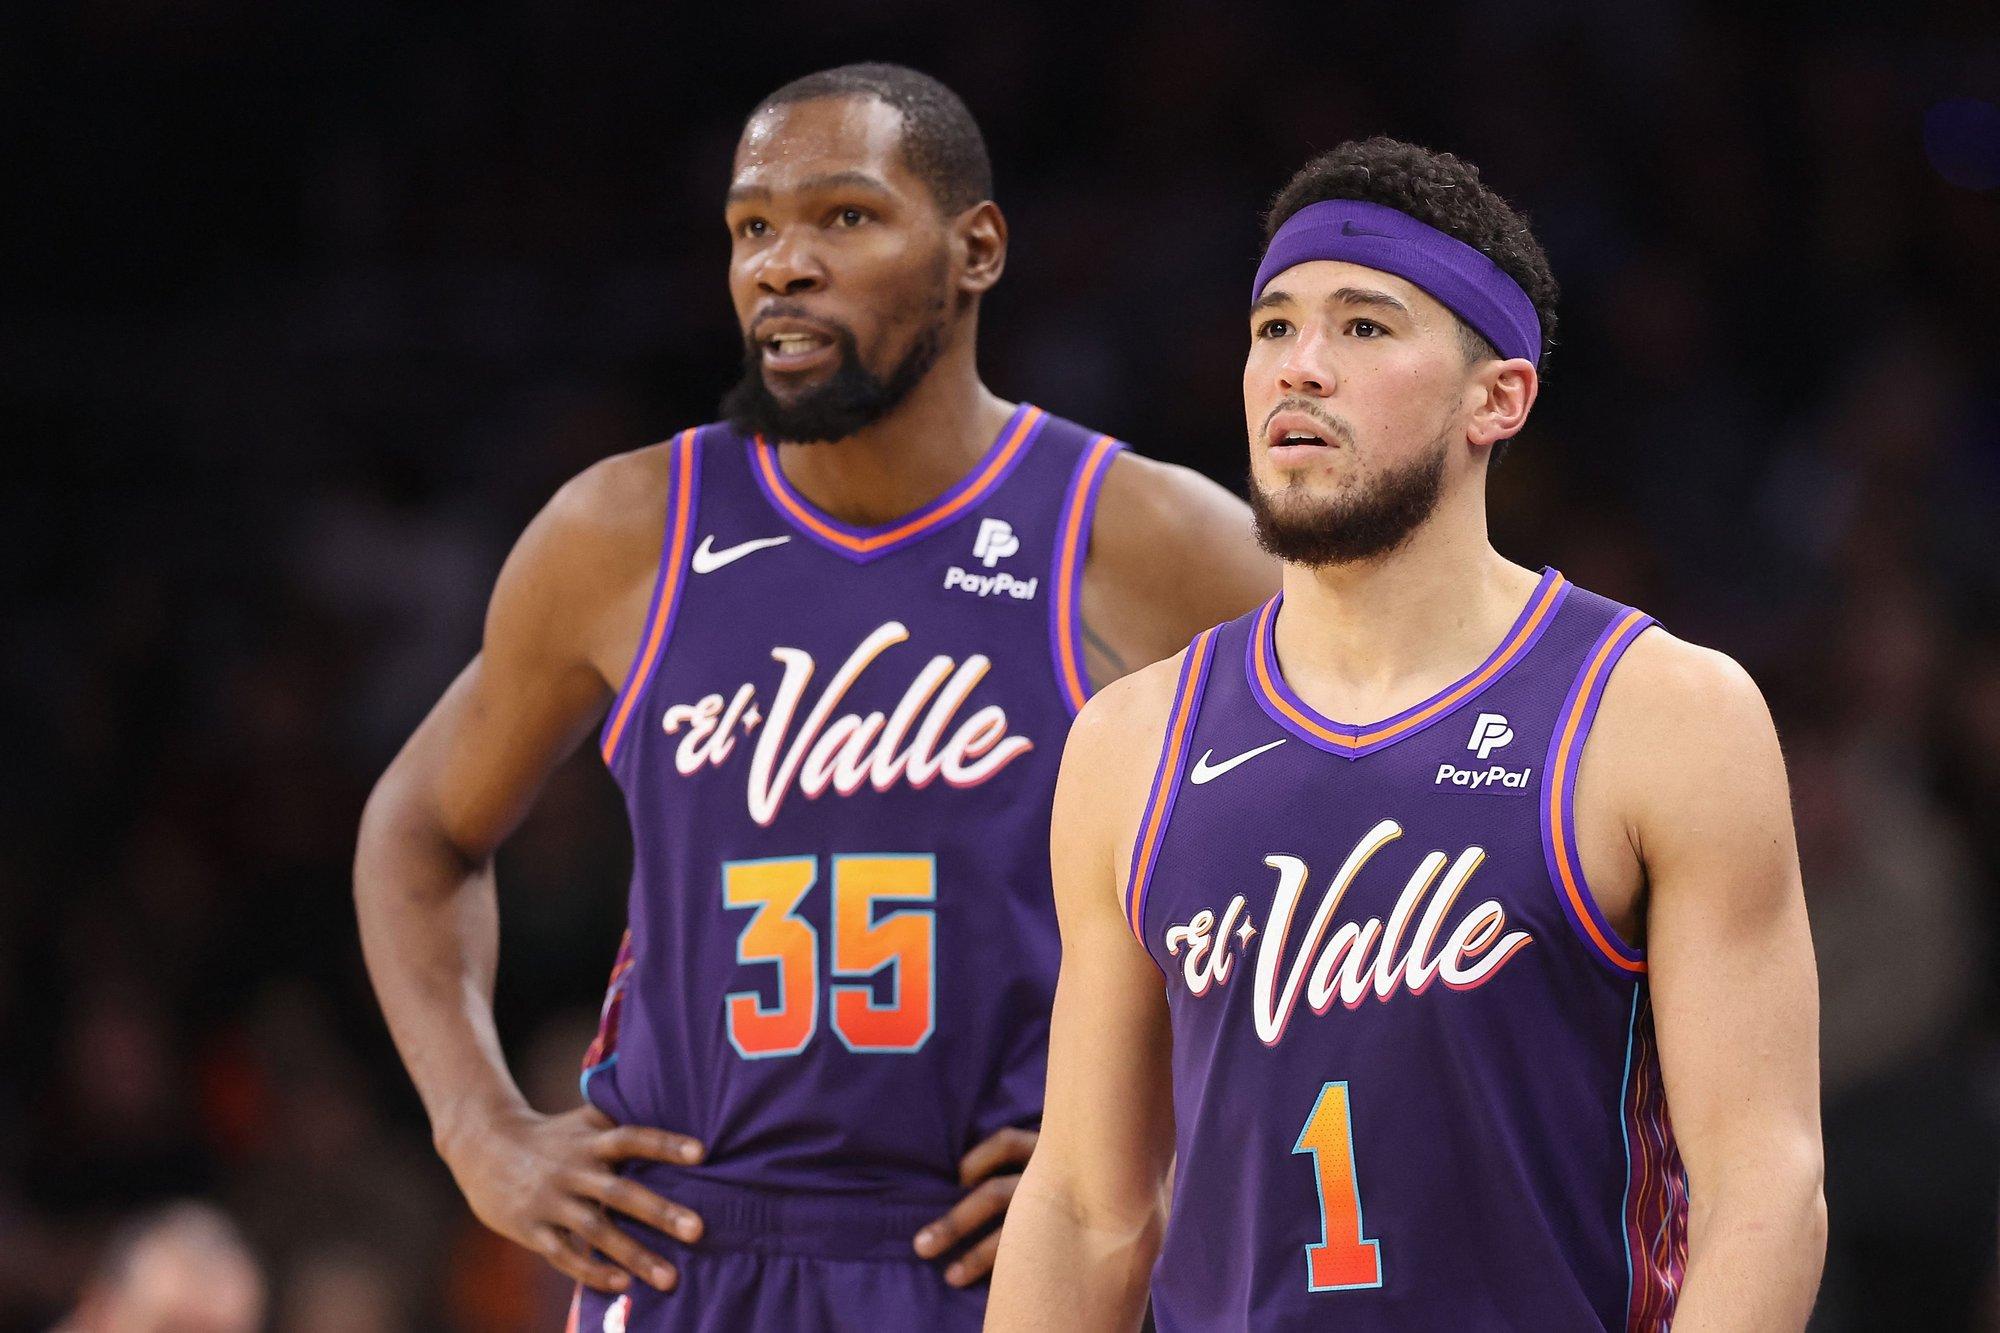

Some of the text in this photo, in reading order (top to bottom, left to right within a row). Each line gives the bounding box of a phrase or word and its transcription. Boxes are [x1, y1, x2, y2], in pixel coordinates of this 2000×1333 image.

[943, 566, 1039, 600] PayPal
[662, 620, 1034, 827] El Valle
[1435, 764, 1532, 789] PayPal
[721, 852, 937, 1061] 35
[1166, 819, 1534, 1047] El Valle
[1291, 1080, 1383, 1292] 1
